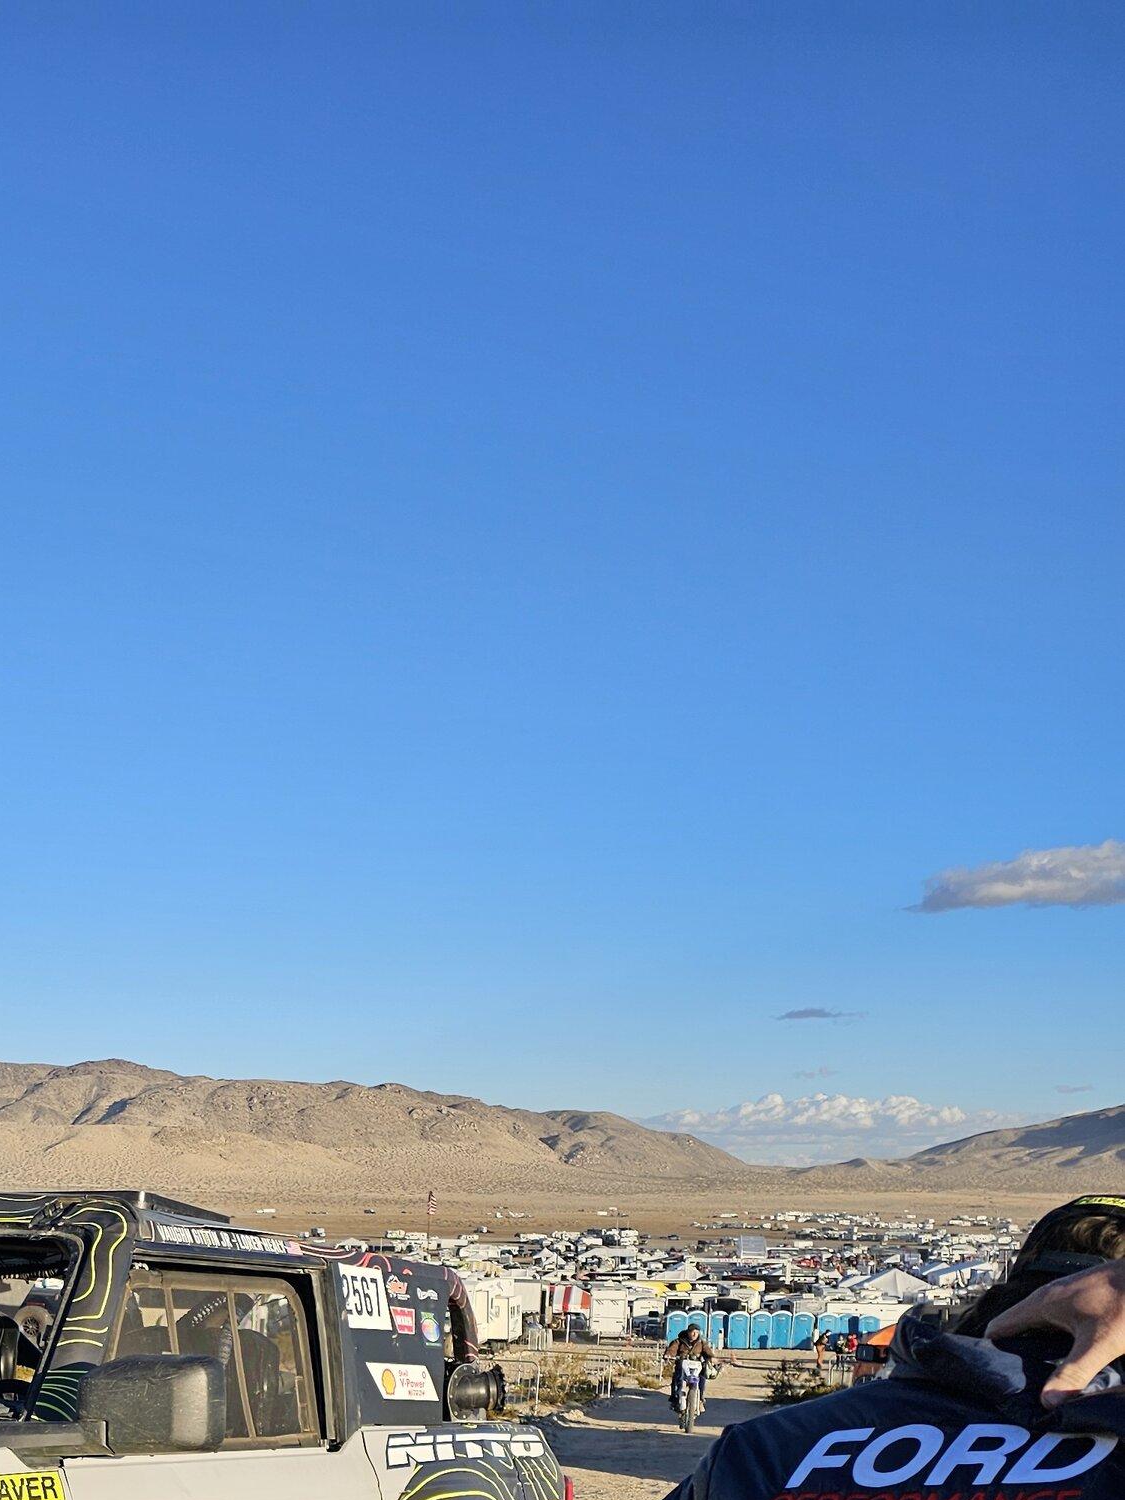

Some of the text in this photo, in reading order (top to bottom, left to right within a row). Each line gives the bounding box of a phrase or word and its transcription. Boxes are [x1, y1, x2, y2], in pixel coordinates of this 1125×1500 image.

[342, 1273, 381, 1317] 2567
[386, 1433, 545, 1469] NITTO
[784, 1423, 1120, 1488] FORD
